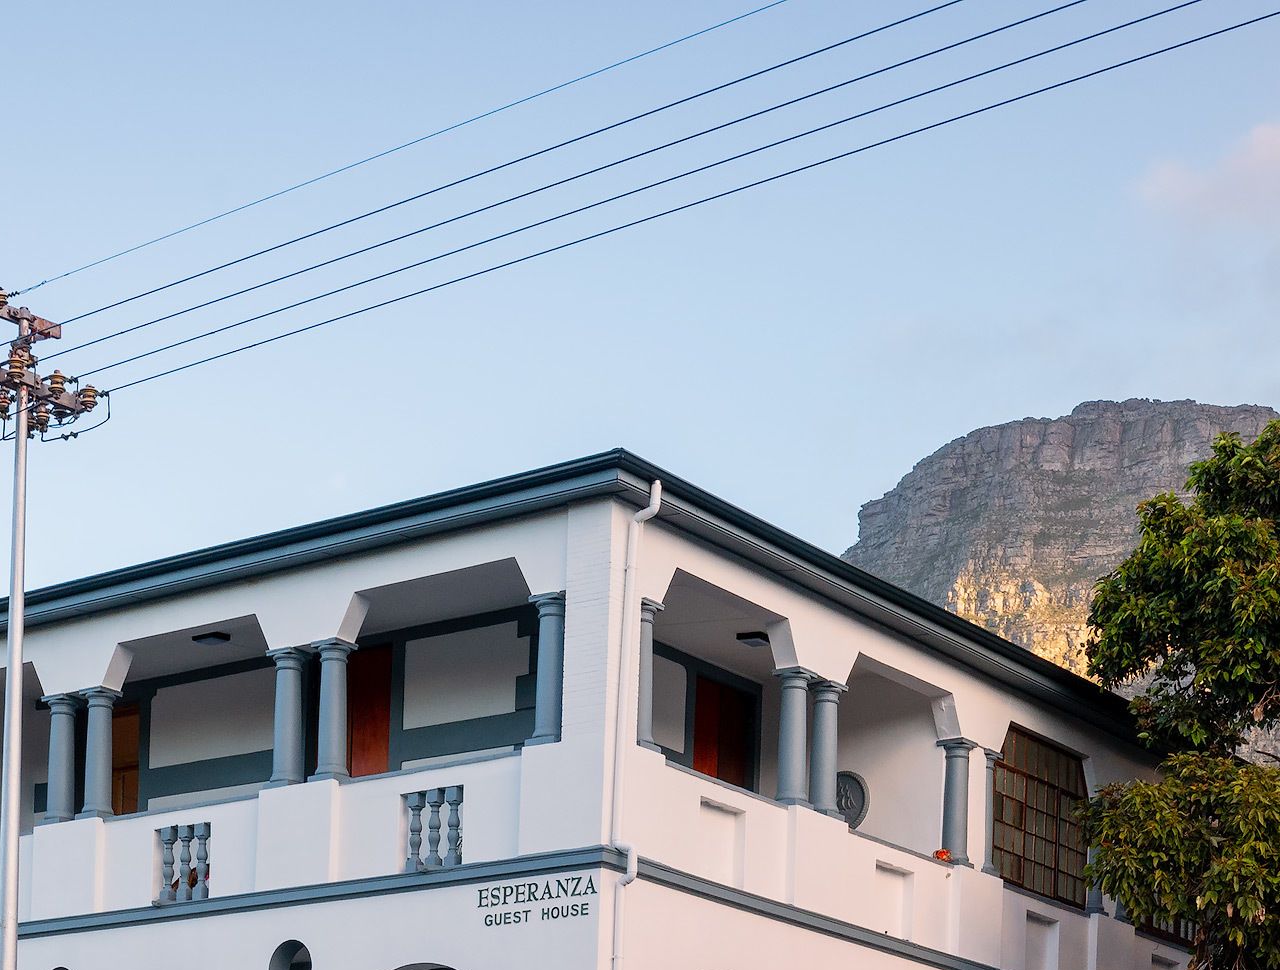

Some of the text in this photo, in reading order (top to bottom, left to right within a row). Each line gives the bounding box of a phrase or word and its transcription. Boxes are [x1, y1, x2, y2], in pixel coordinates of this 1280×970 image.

[477, 875, 597, 908] ESPERANZA
[484, 902, 589, 927] GUEST HOUSE
